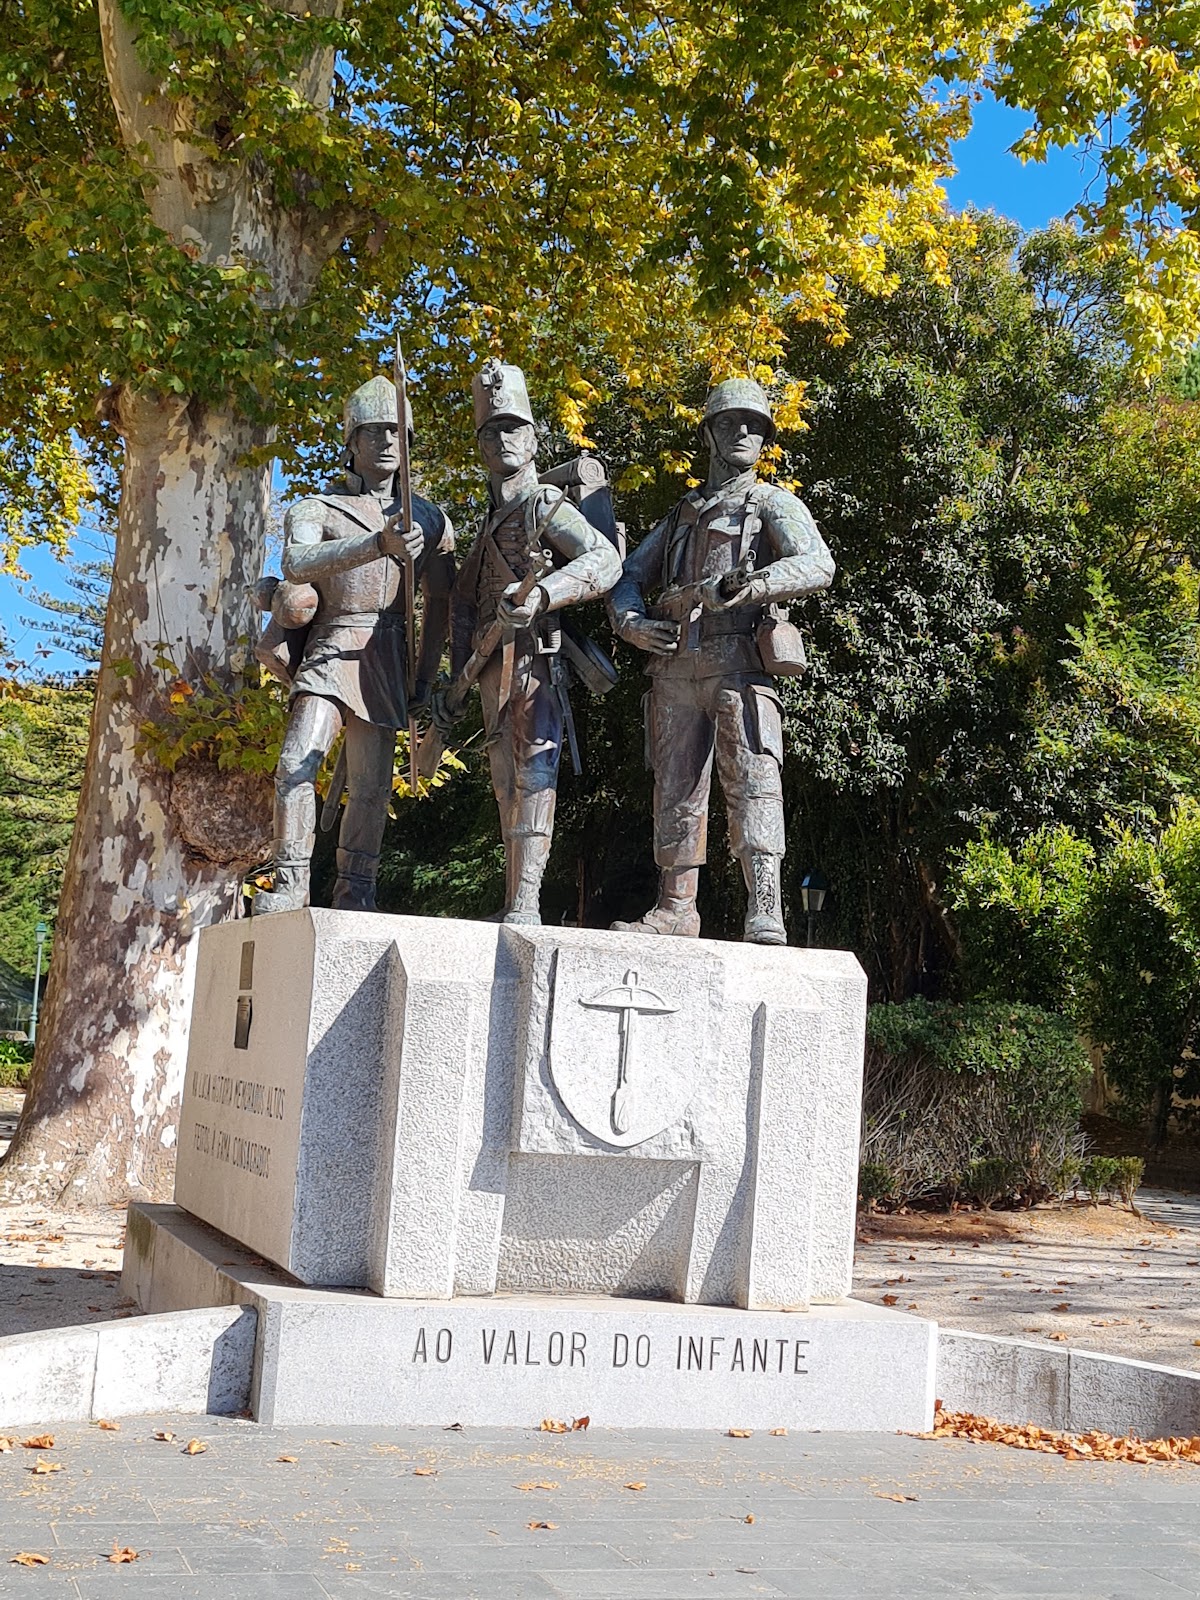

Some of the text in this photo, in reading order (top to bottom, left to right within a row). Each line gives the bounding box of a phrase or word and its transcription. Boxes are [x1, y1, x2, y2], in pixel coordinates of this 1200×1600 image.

[264, 1086, 285, 1120] ALTOS
[411, 1326, 811, 1376] AO VALOR DO INFANTE
